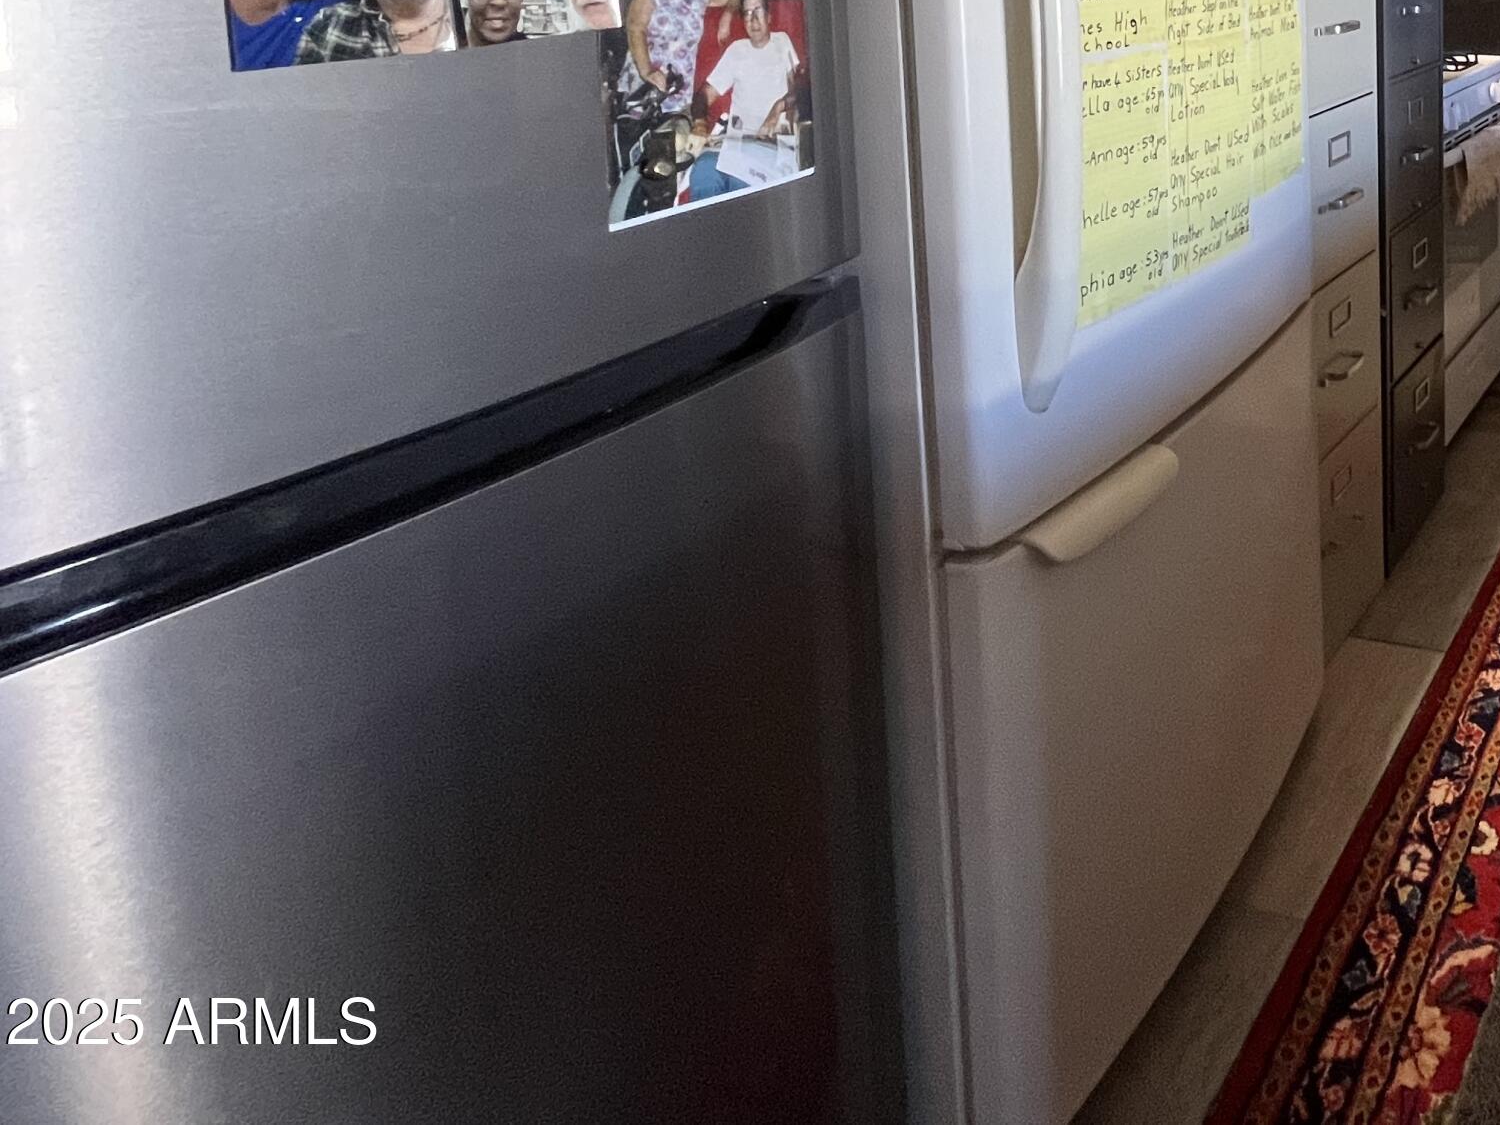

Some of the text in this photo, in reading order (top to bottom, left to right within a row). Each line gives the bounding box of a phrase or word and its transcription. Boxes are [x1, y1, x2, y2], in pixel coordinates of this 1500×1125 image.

[1114, 7, 1148, 35] High
[1171, 185, 1218, 214] Shampoo
[1082, 200, 1118, 229] helle
[1080, 269, 1116, 307] phia
